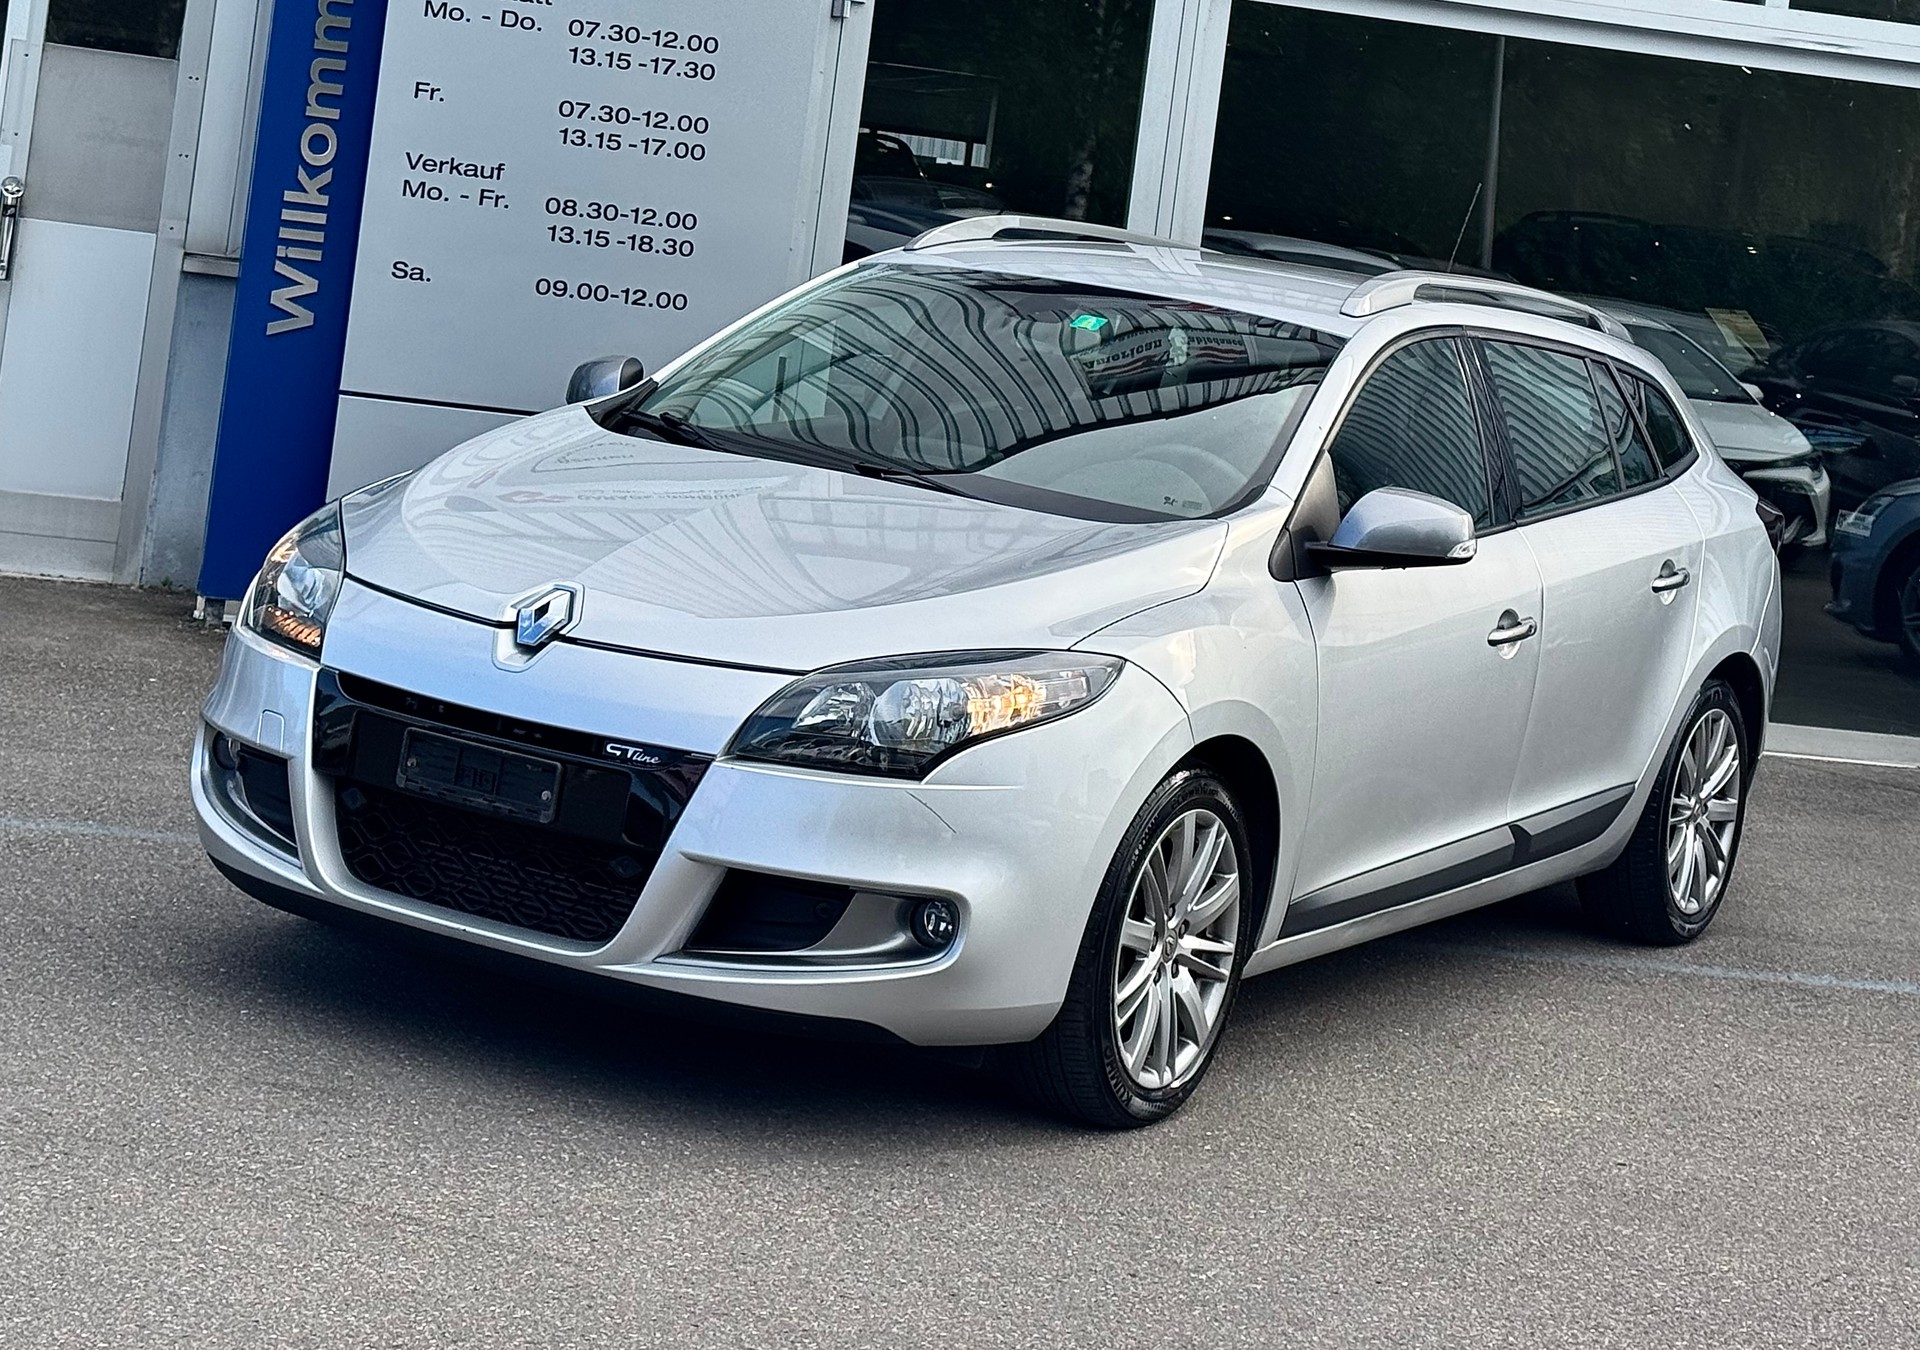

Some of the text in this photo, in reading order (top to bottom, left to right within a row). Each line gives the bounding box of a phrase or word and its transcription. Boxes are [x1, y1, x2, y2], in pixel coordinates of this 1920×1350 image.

[423, 0, 471, 23] Mo.
[500, 9, 542, 32] Do.
[568, 19, 719, 54] 07.30-12.00
[413, 81, 709, 135] Fr. 07.30-12.00
[405, 151, 506, 181] Verkauf
[402, 179, 450, 202] Mo.
[478, 188, 509, 209] Fr.
[545, 197, 698, 231] 08.30-12.00
[391, 260, 688, 311] Sa. 09.00-12.00
